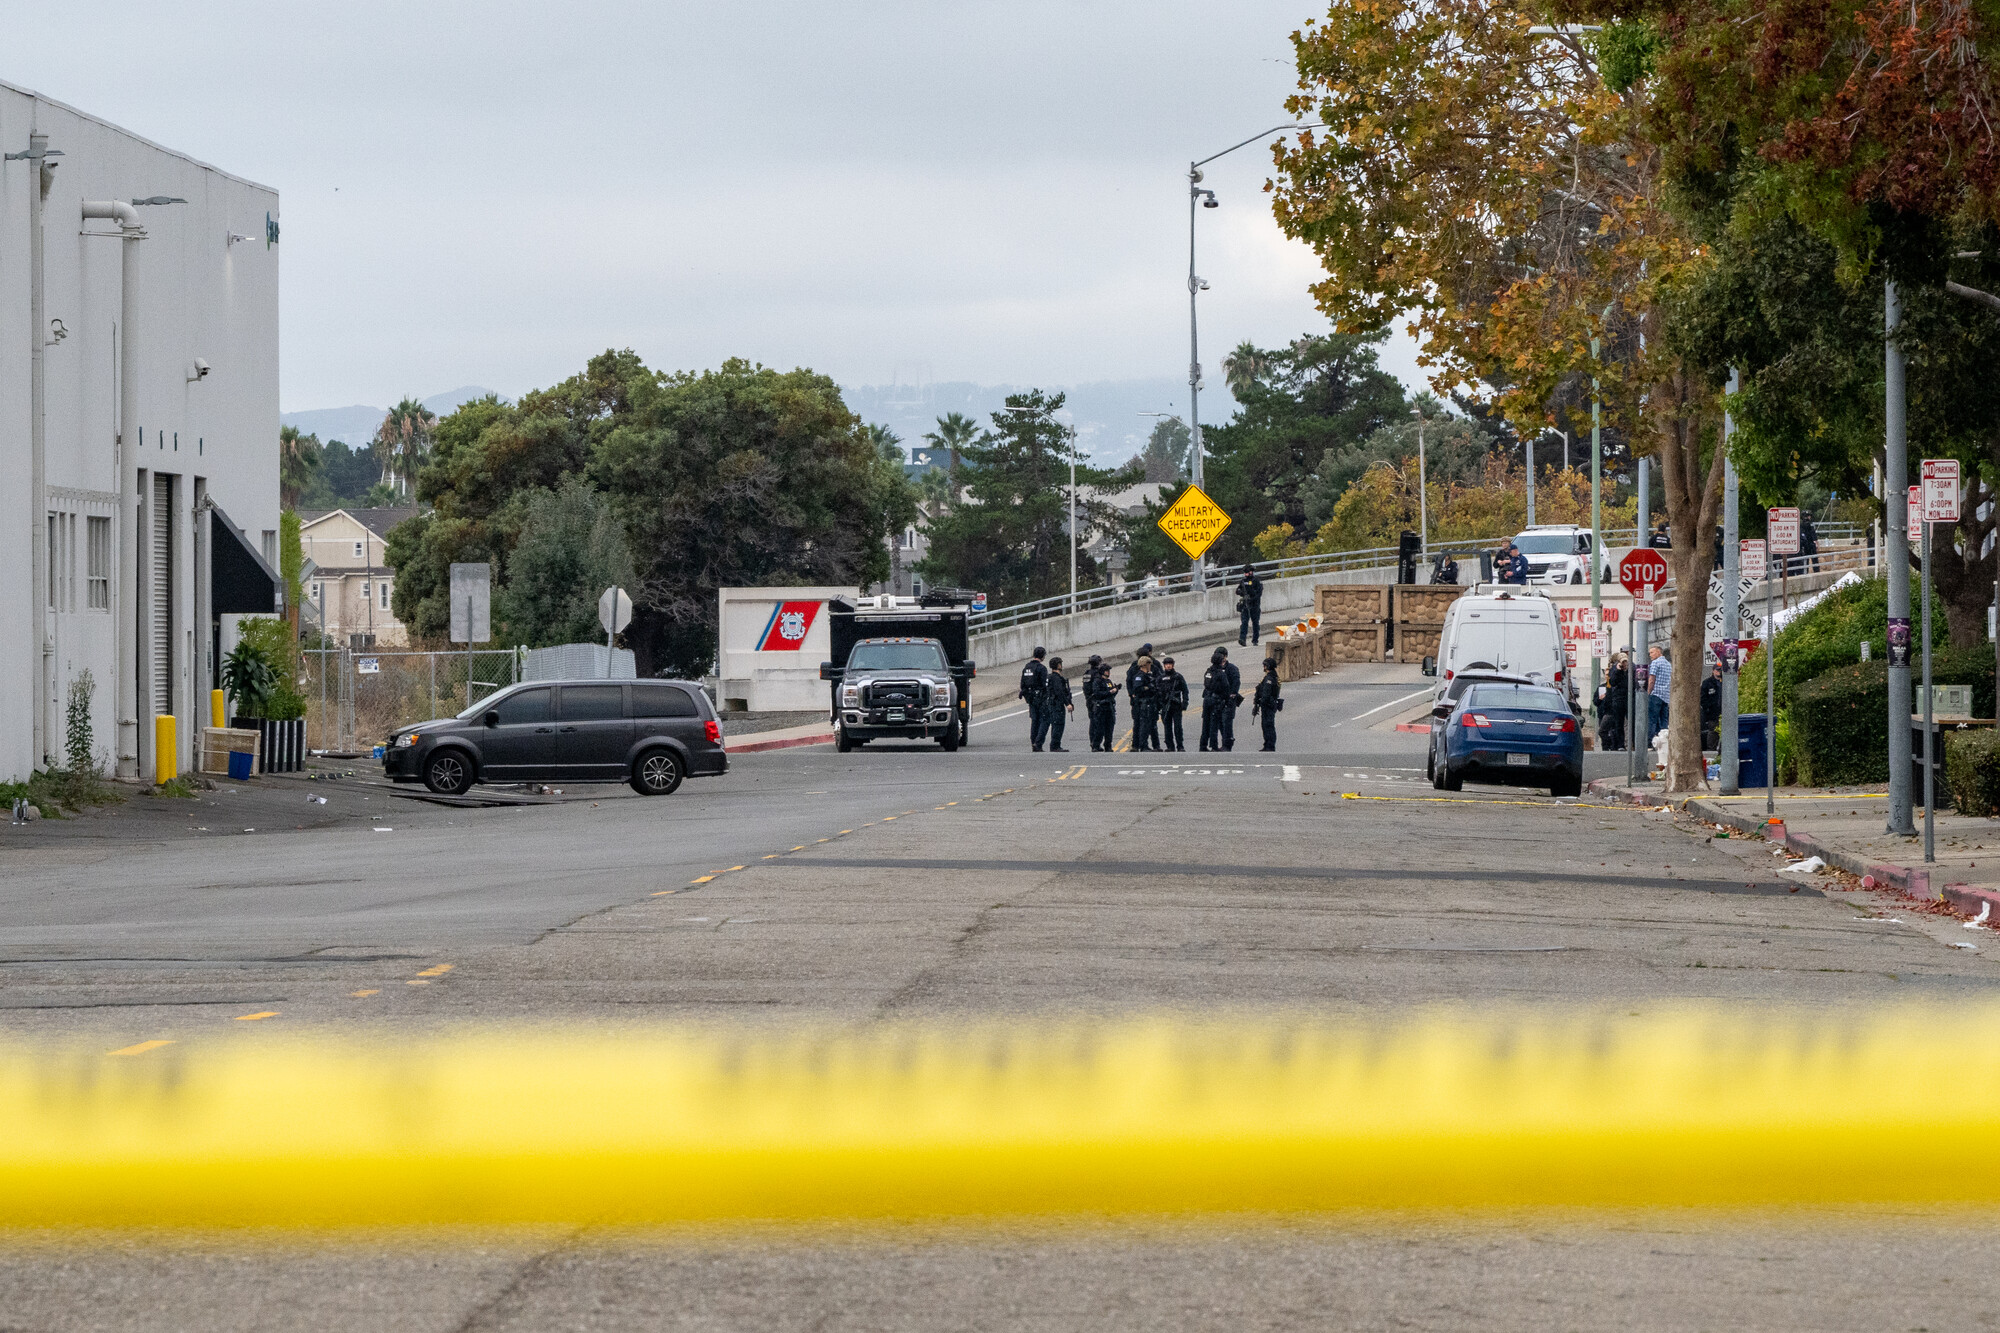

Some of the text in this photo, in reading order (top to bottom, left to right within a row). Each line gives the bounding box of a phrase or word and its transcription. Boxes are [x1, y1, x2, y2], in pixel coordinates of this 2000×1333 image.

[1924, 464, 1956, 476] NO PARKING
[1930, 500, 1952, 508] 6:00PM
[1175, 506, 1213, 517] MILITARY
[1168, 519, 1220, 530] CHECKPOINT
[1182, 532, 1211, 542] AHEAD
[1622, 564, 1664, 582] STOP
